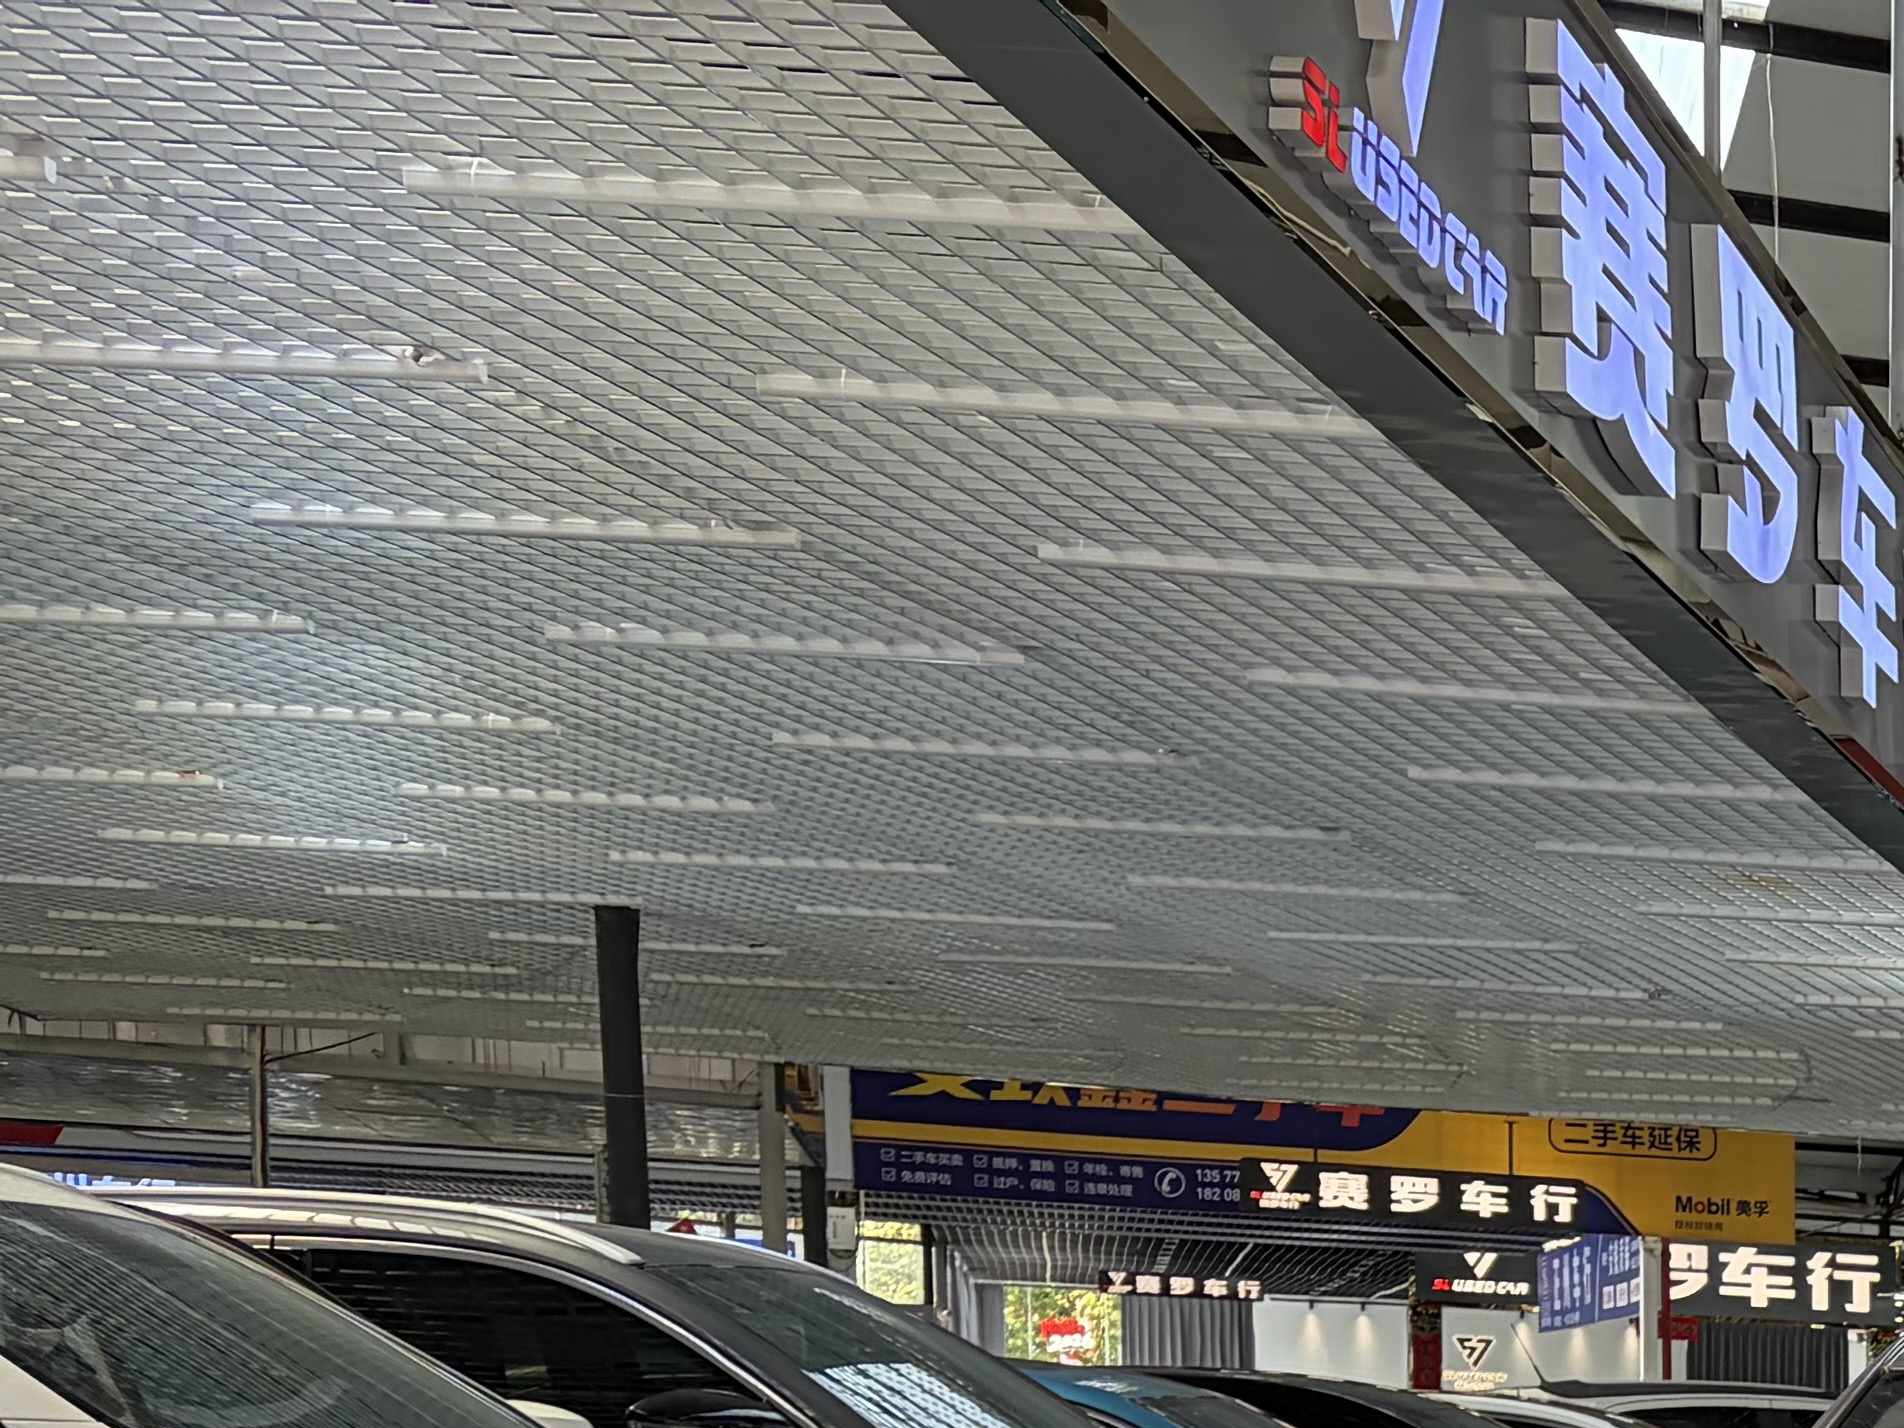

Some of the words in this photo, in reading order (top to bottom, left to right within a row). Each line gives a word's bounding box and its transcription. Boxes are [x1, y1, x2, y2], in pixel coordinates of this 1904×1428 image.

[1563, 1122, 1702, 1154] 二手车延保
[1196, 1169, 1221, 1183] 135
[1196, 1187, 1221, 1201] 182
[1318, 1170, 1579, 1225] 赛罗车行
[1674, 1195, 1731, 1217] Mobil
[1735, 1199, 1771, 1219] 美孚
